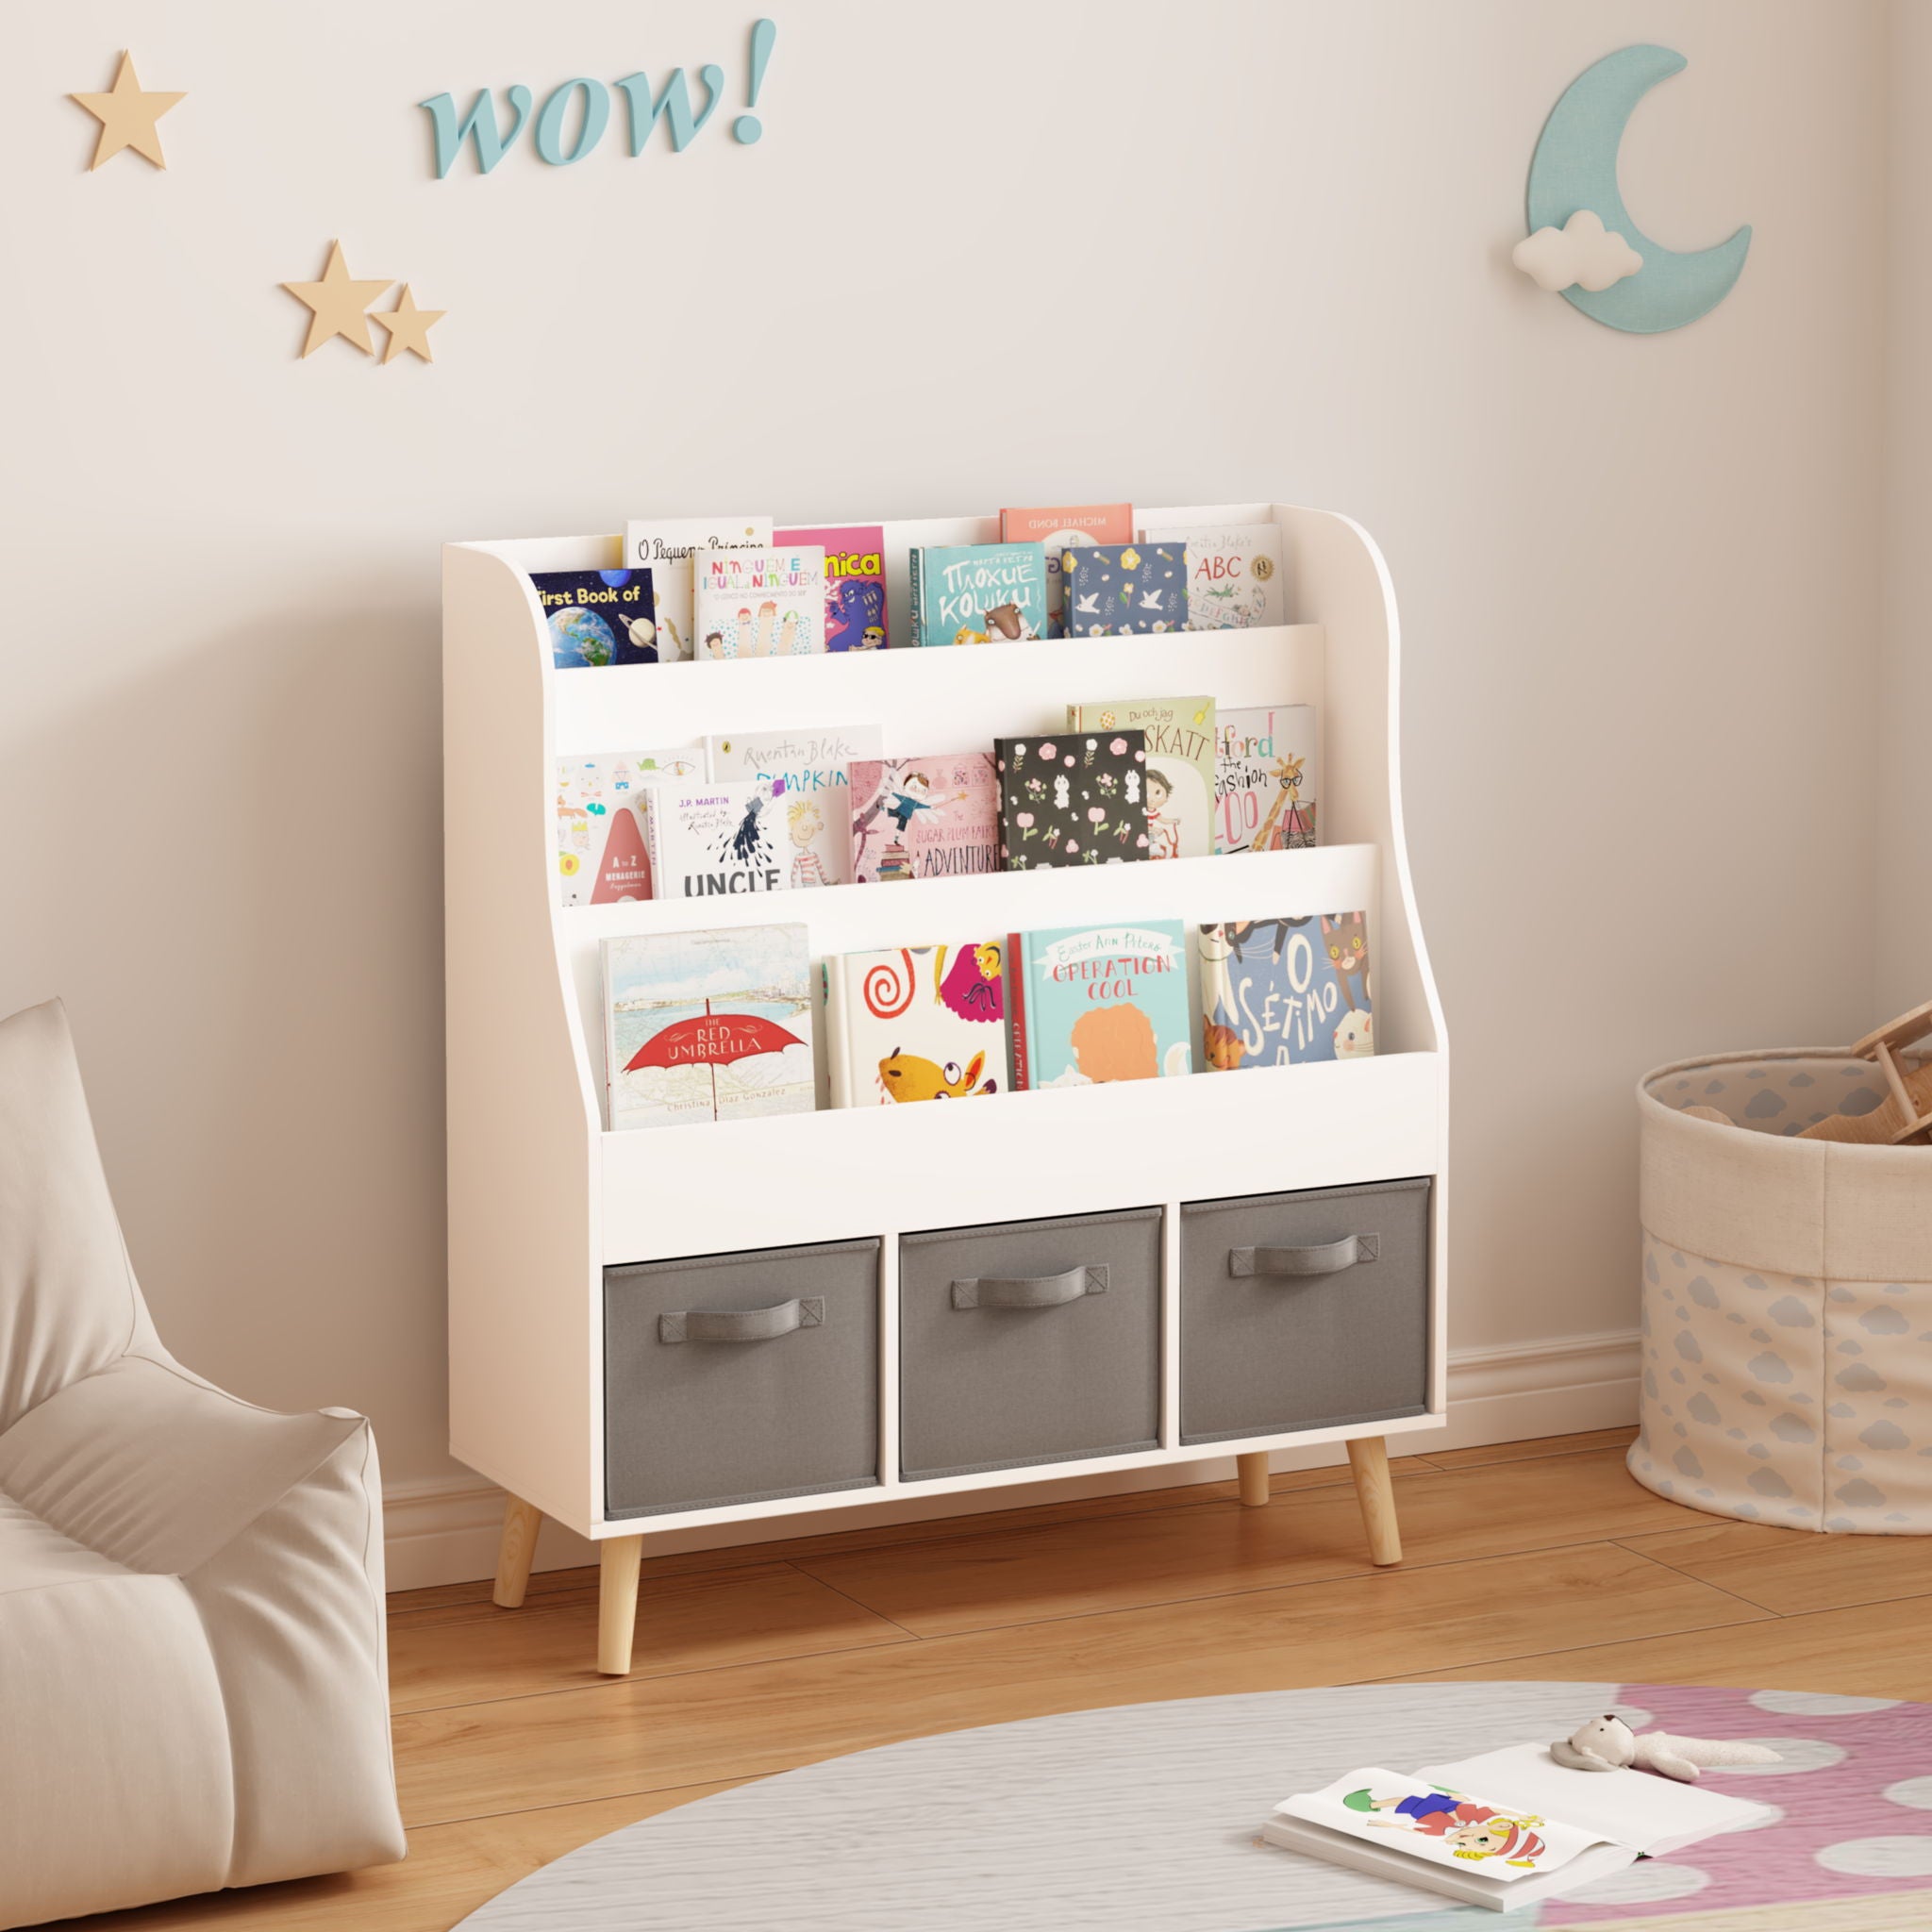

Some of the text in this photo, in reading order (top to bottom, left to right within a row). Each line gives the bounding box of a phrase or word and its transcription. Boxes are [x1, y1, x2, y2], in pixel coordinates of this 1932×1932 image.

[418, 18, 777, 179] wow!
[638, 539, 649, 560] O
[653, 538, 705, 565] Pequen
[1194, 556, 1241, 581] ABC
[576, 587, 619, 604] Book
[623, 585, 641, 602] of
[1128, 707, 1174, 723] Du och jag
[743, 737, 858, 770] Quentin Blake
[1222, 757, 1241, 773] the
[757, 770, 848, 791] MPKIN
[679, 797, 729, 808] J.P. MARTIN
[916, 828, 945, 843] SUGAR
[612, 856, 620, 868] A
[630, 855, 638, 867] Z
[1052, 955, 1171, 982] OPERATION
[1287, 933, 1313, 993] O
[1087, 978, 1139, 1001] COOL
[705, 1018, 722, 1026] THE
[696, 1025, 731, 1042] RED
[668, 1037, 761, 1059] UMBRELLA
